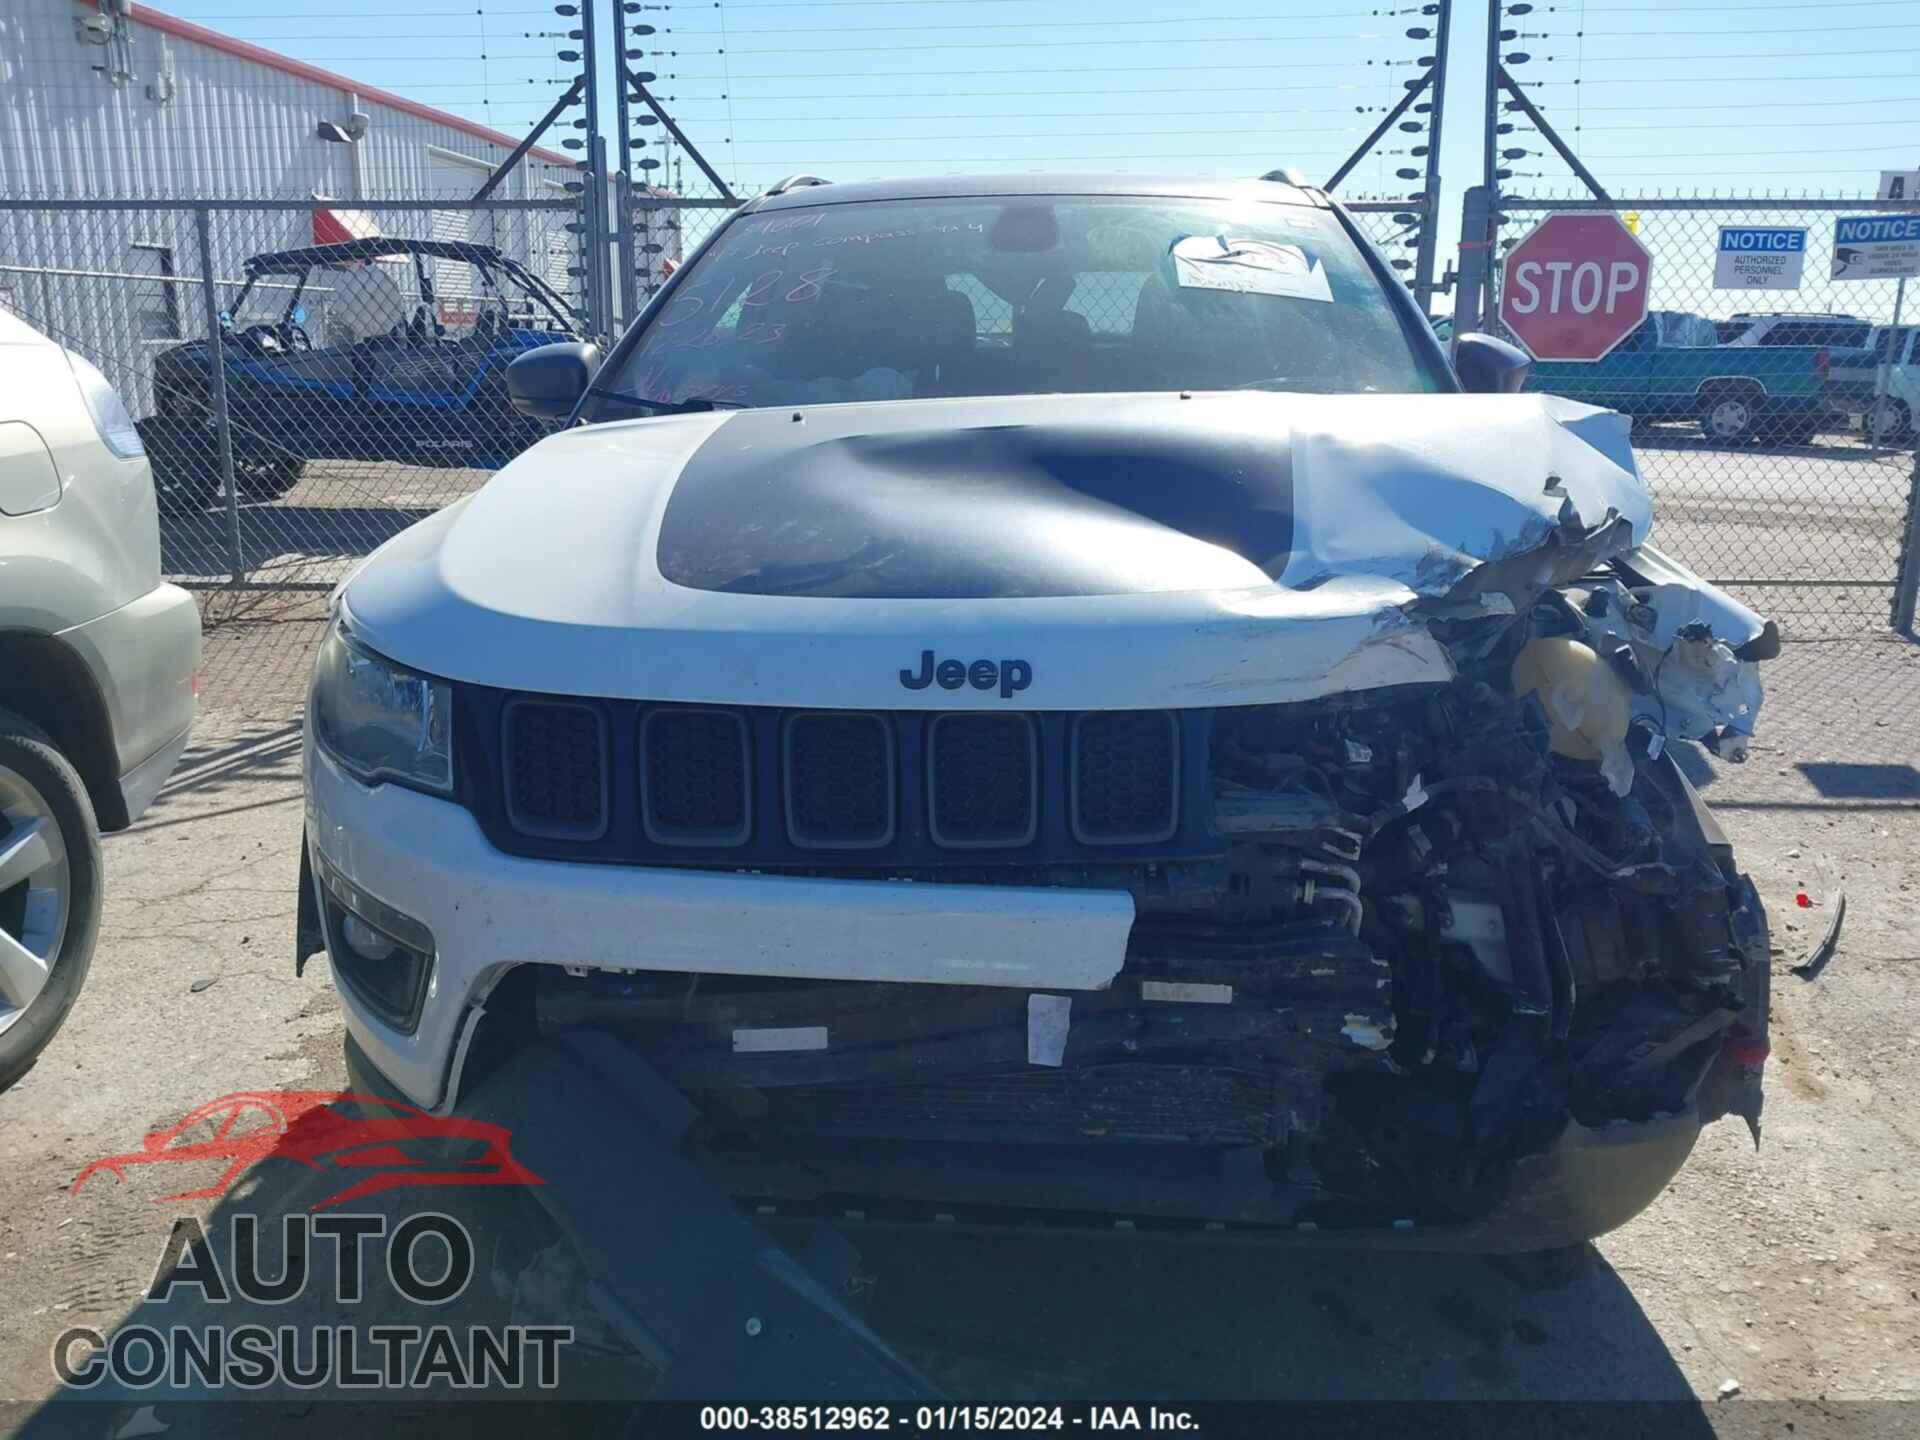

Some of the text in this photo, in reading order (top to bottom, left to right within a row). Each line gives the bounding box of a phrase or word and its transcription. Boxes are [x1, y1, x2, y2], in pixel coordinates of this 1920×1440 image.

[1840, 218, 1920, 239] NOTICE
[1725, 232, 1800, 249] NOTICE
[1734, 255, 1786, 265] AUTHORIZED
[1734, 265, 1784, 275] PERSONNEL
[1512, 261, 1640, 314] STOP
[1746, 275, 1769, 285] ONLY
[899, 650, 1033, 698] Jeep
